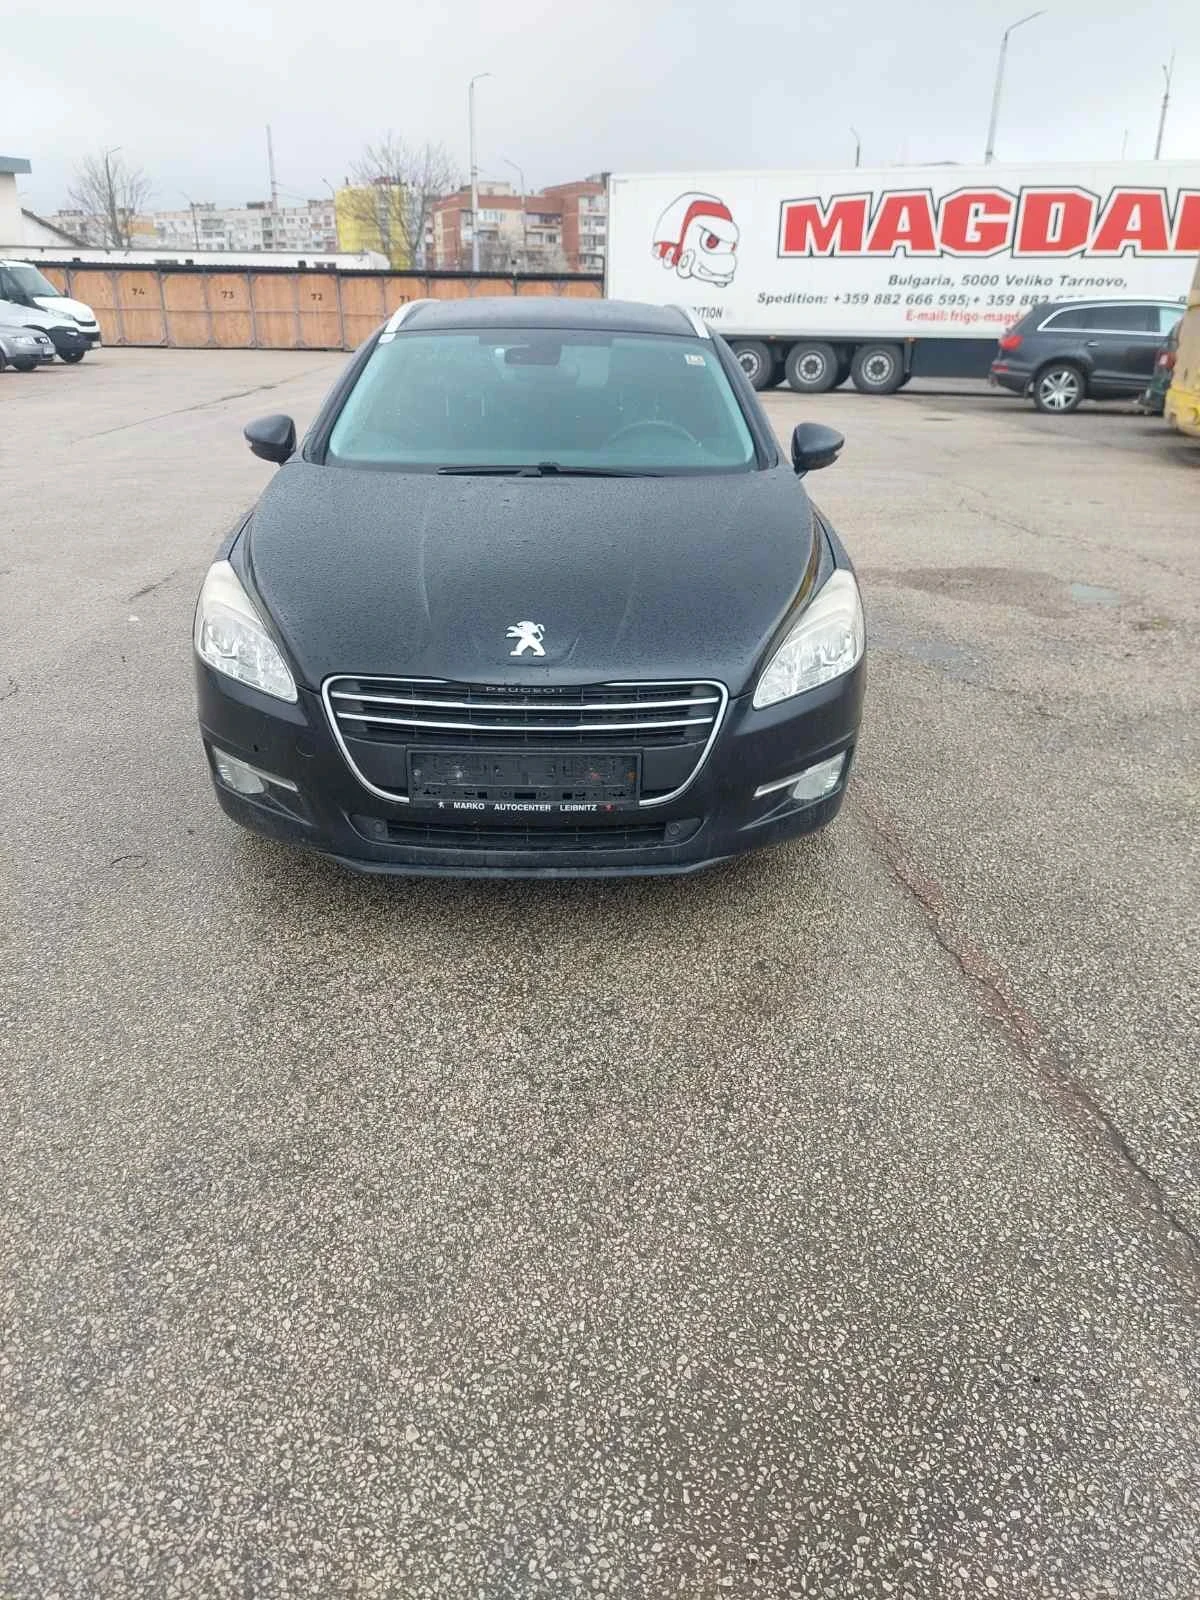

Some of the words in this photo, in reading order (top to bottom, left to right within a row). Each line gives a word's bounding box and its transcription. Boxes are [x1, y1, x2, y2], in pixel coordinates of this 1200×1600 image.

[888, 274, 954, 288] Bulgaria,
[961, 275, 999, 287] 5000
[1005, 274, 1053, 287] Veliko
[1059, 275, 1127, 288] Tarnovo,
[131, 287, 145, 296] 74
[220, 290, 235, 299] 73
[310, 293, 323, 301] 72
[757, 291, 828, 306] Spedition:
[834, 293, 869, 305] +359
[873, 293, 901, 305] 882
[905, 294, 933, 306] 666
[986, 294, 1016, 306] 359
[453, 802, 485, 810] MARKO
[494, 803, 551, 812] AUTOCENTER
[559, 803, 598, 812] LEIBNITZ
